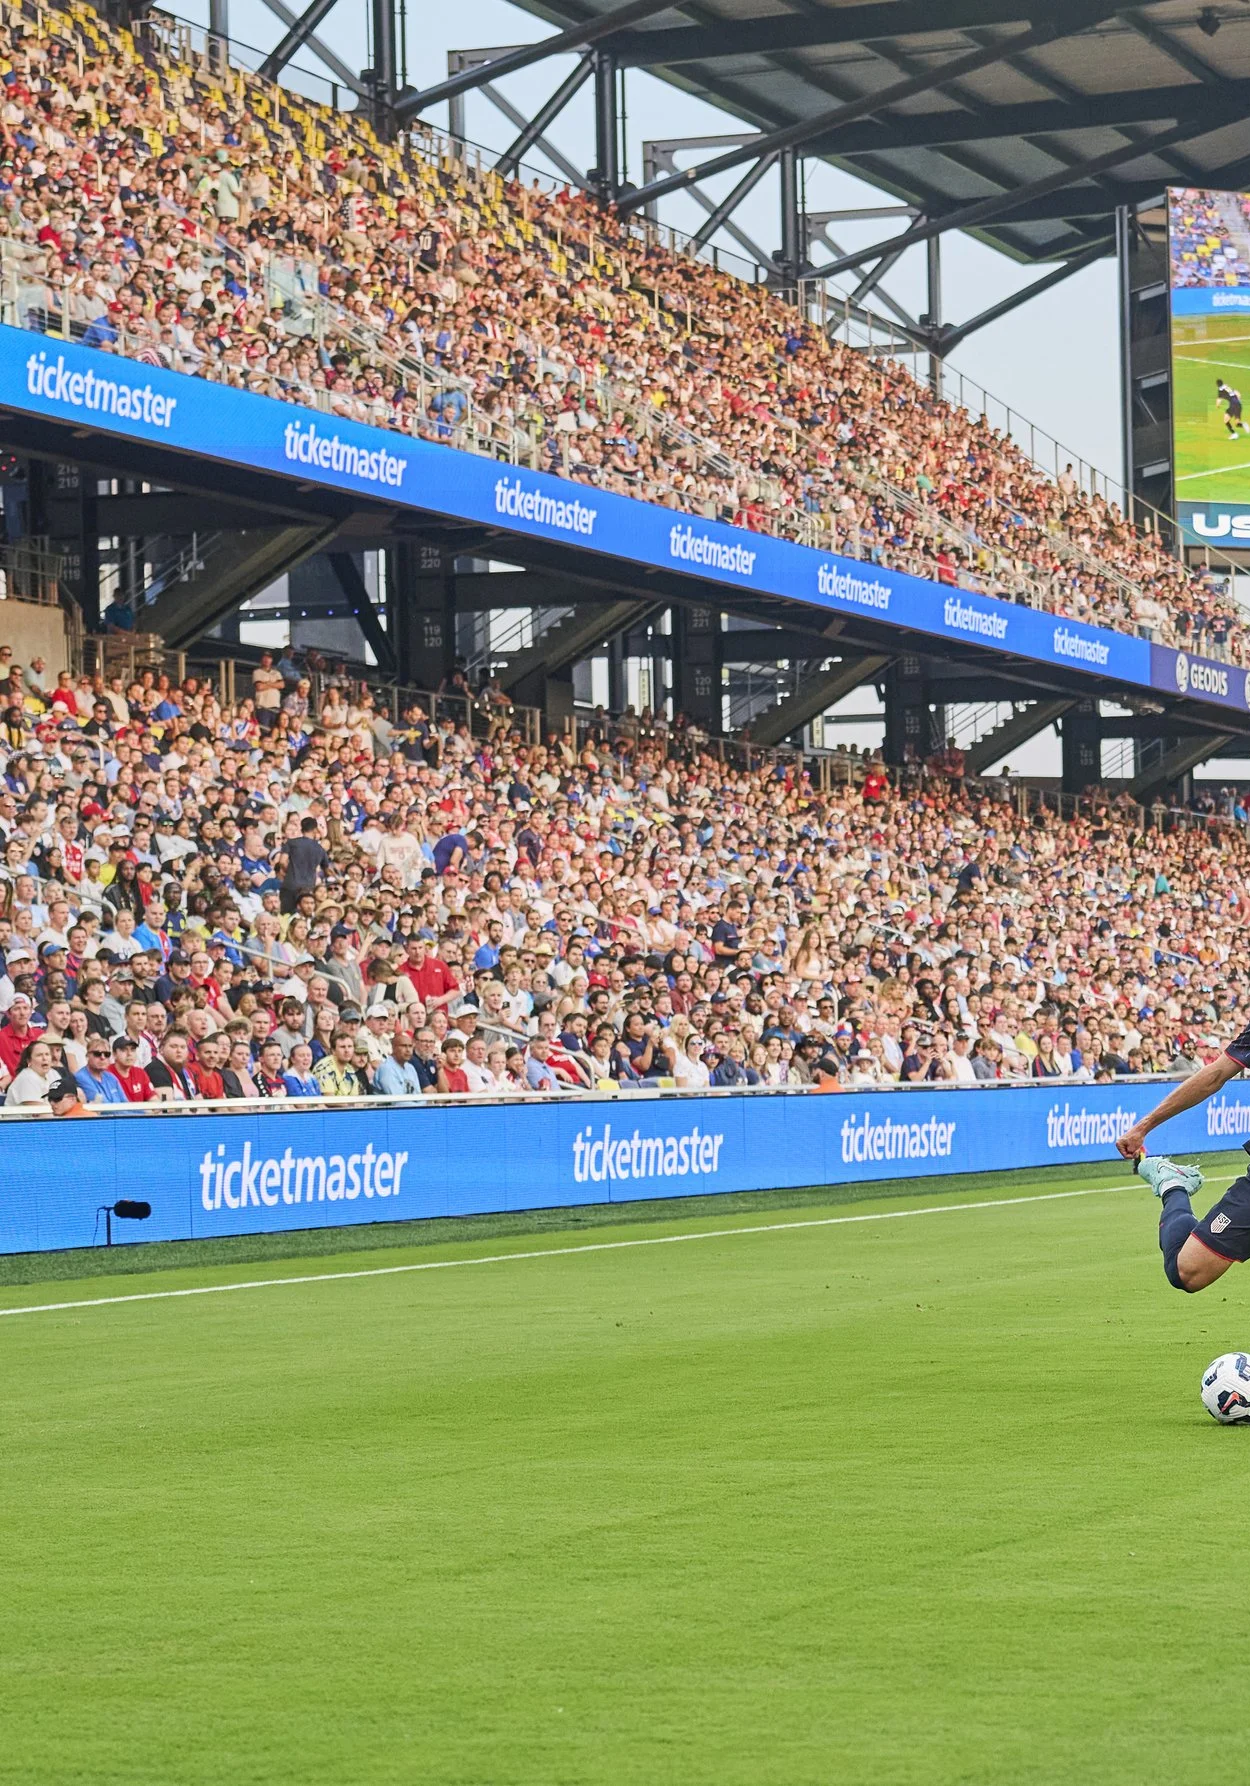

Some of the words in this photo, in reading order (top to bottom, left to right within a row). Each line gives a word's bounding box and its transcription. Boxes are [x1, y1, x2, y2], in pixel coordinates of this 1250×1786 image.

[418, 234, 433, 251] 10
[26, 352, 177, 427] ticketmaster
[284, 421, 408, 488] ticketmaster
[494, 477, 597, 536] ticketmaster
[669, 523, 756, 576] ticketmaster
[817, 563, 892, 610] ticketmaster
[944, 596, 1009, 639] ticketmaster
[423, 636, 442, 648] 120
[1053, 627, 1111, 665] ticketmaster
[694, 676, 712, 686] 120
[695, 686, 711, 696] 121
[1190, 662, 1229, 696] GEODIS
[841, 1112, 956, 1163] ticketmaster
[1047, 1102, 1137, 1149] ticketmaster
[199, 1141, 409, 1211] ticketmaster
[572, 1123, 724, 1183] ticketmaster
